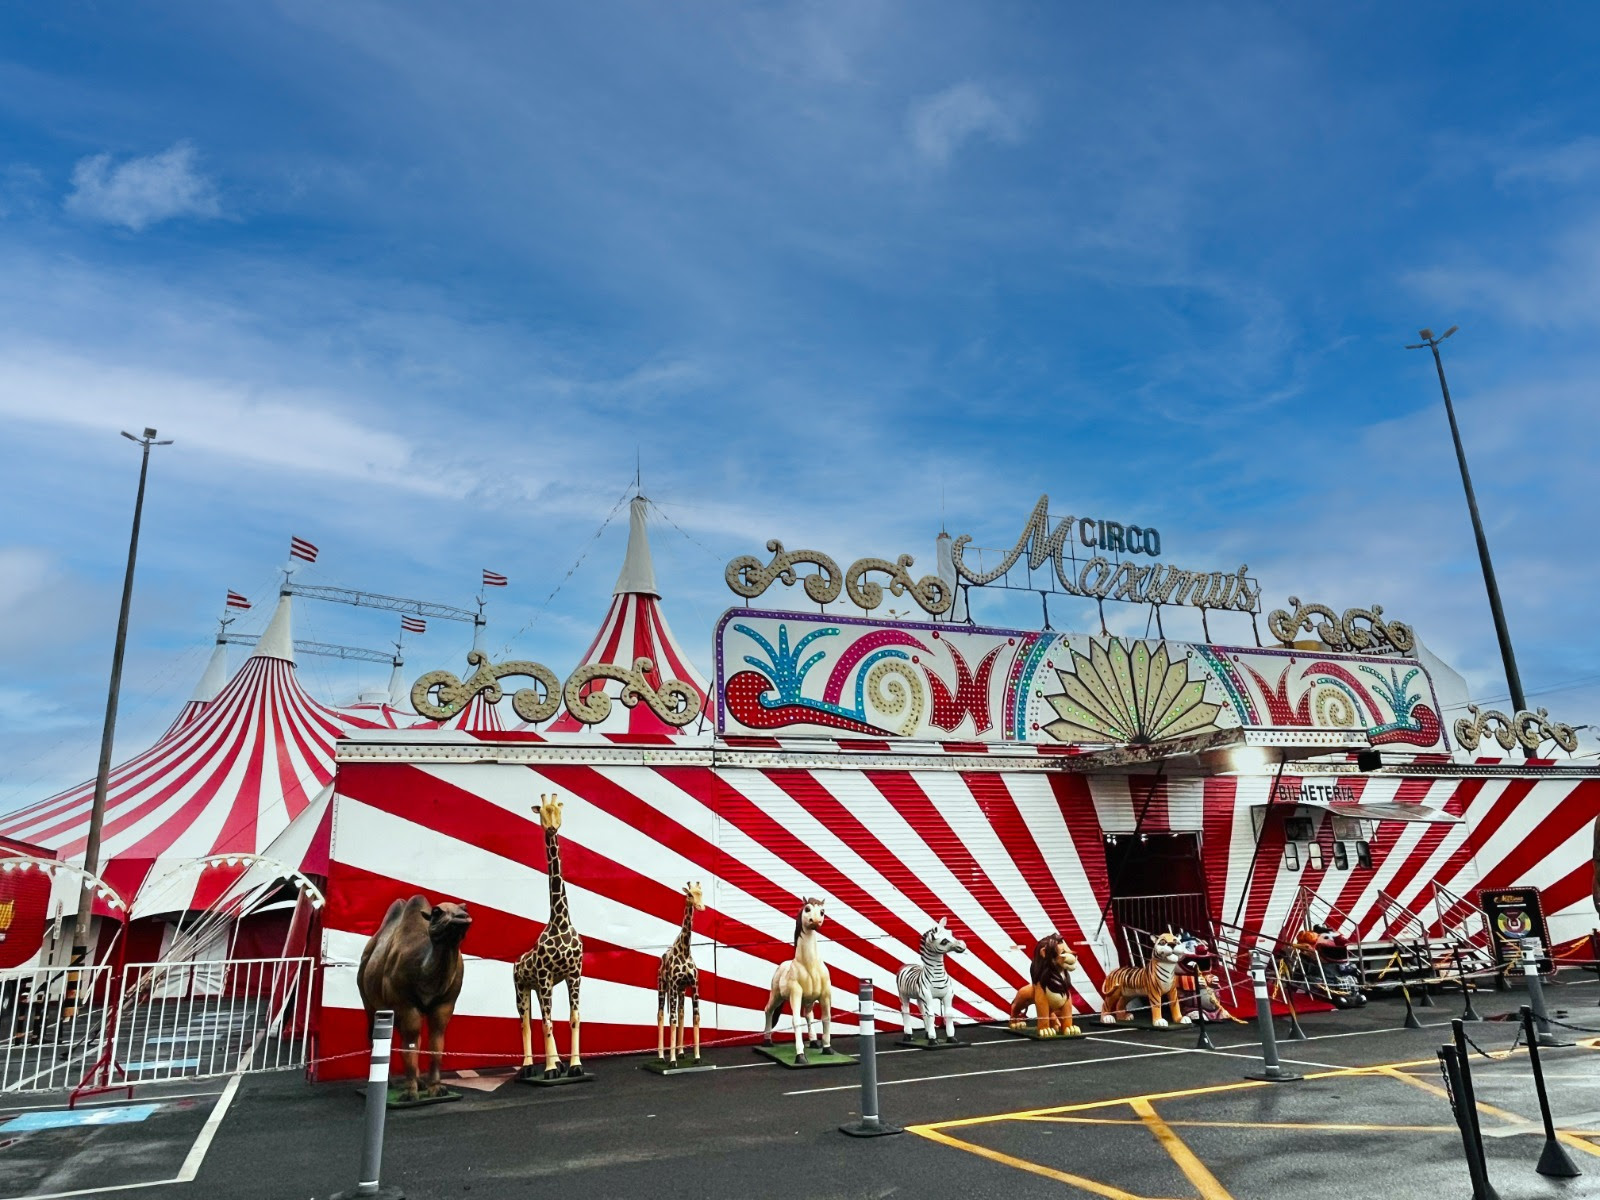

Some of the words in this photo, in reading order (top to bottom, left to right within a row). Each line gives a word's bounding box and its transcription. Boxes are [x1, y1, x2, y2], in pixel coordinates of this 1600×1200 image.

[952, 494, 1262, 612] Maximus
[1079, 517, 1161, 556] CIRCO
[1279, 785, 1354, 801] BILHETERIA
